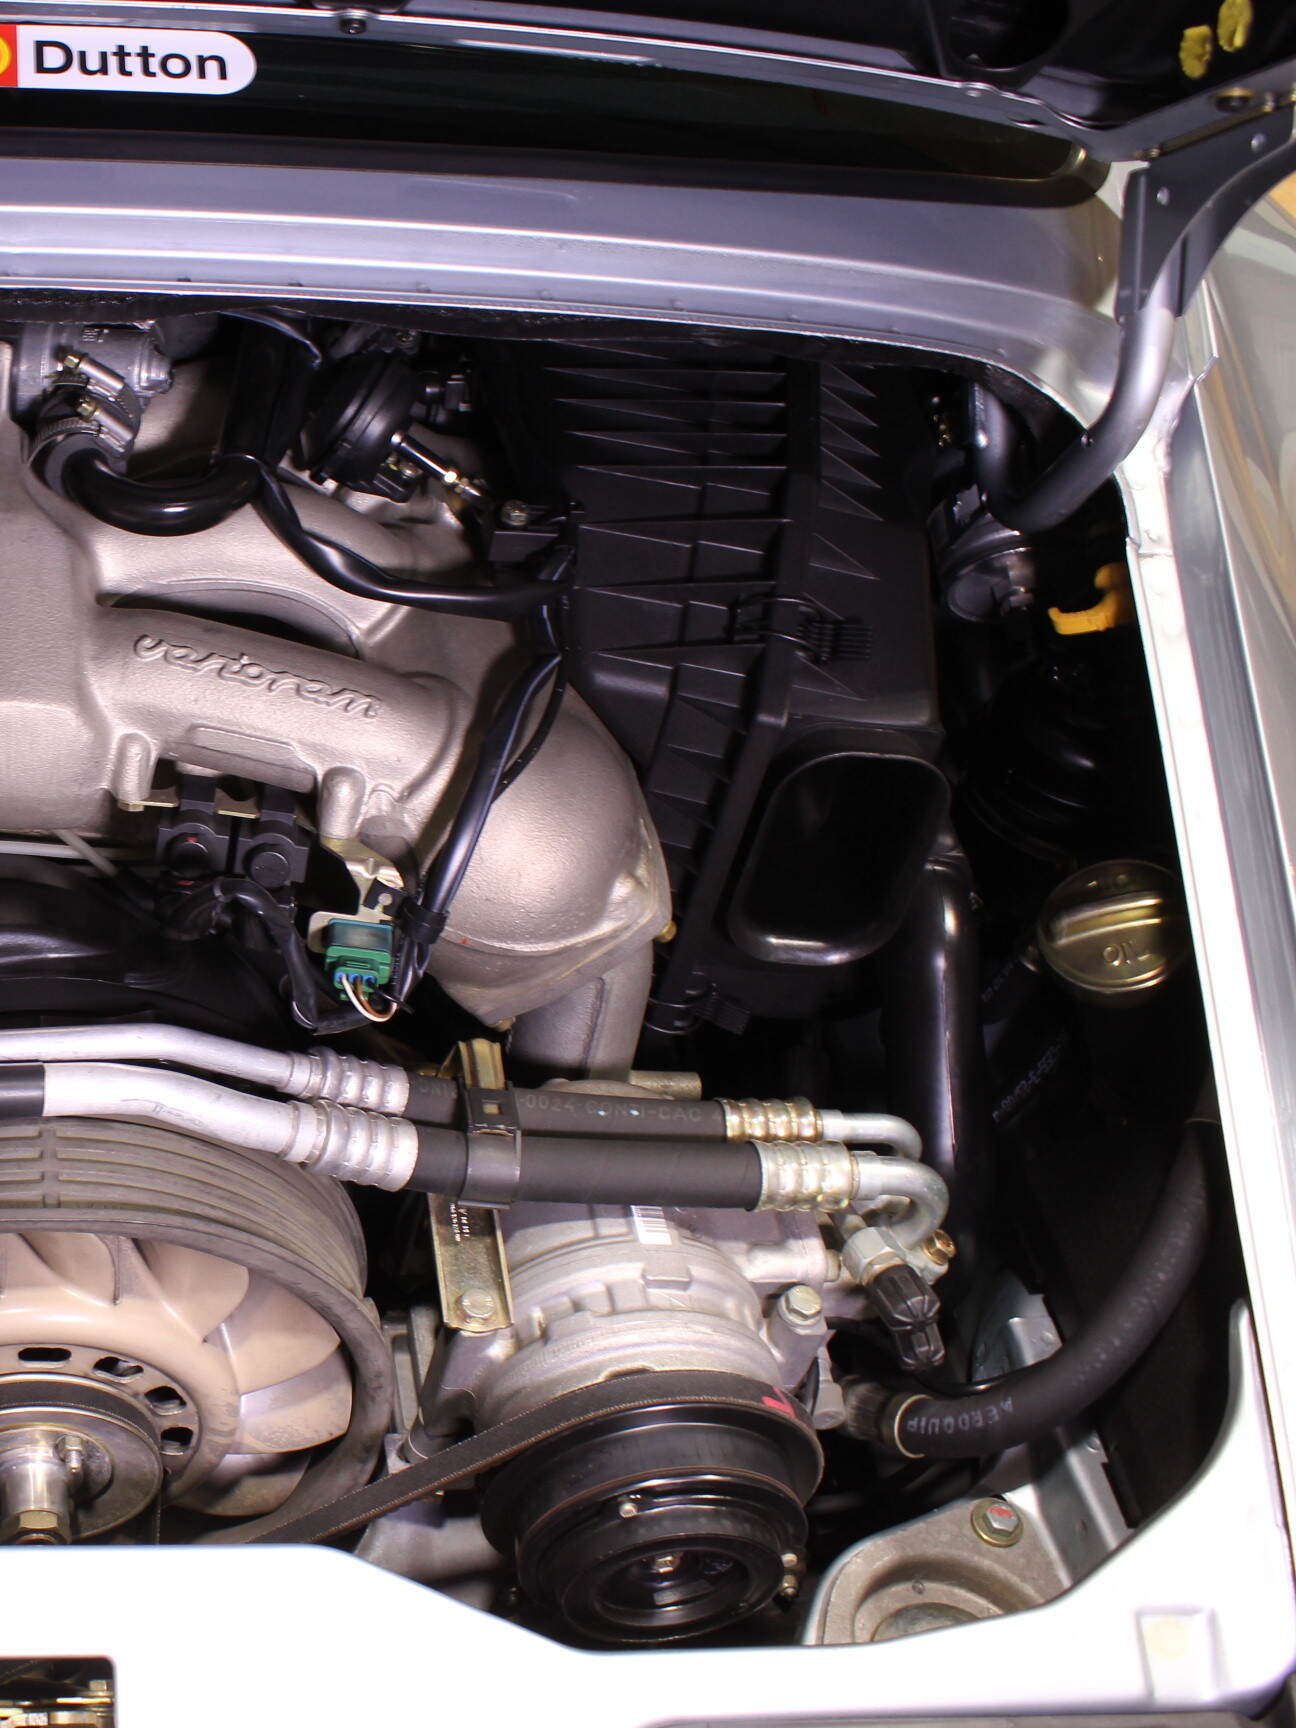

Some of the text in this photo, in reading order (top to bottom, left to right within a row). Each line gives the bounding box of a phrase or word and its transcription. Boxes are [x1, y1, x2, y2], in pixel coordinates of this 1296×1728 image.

[33, 40, 228, 80] Dutton
[1101, 941, 1151, 967] OIL
[907, 1397, 1013, 1436] AEROQUIP
